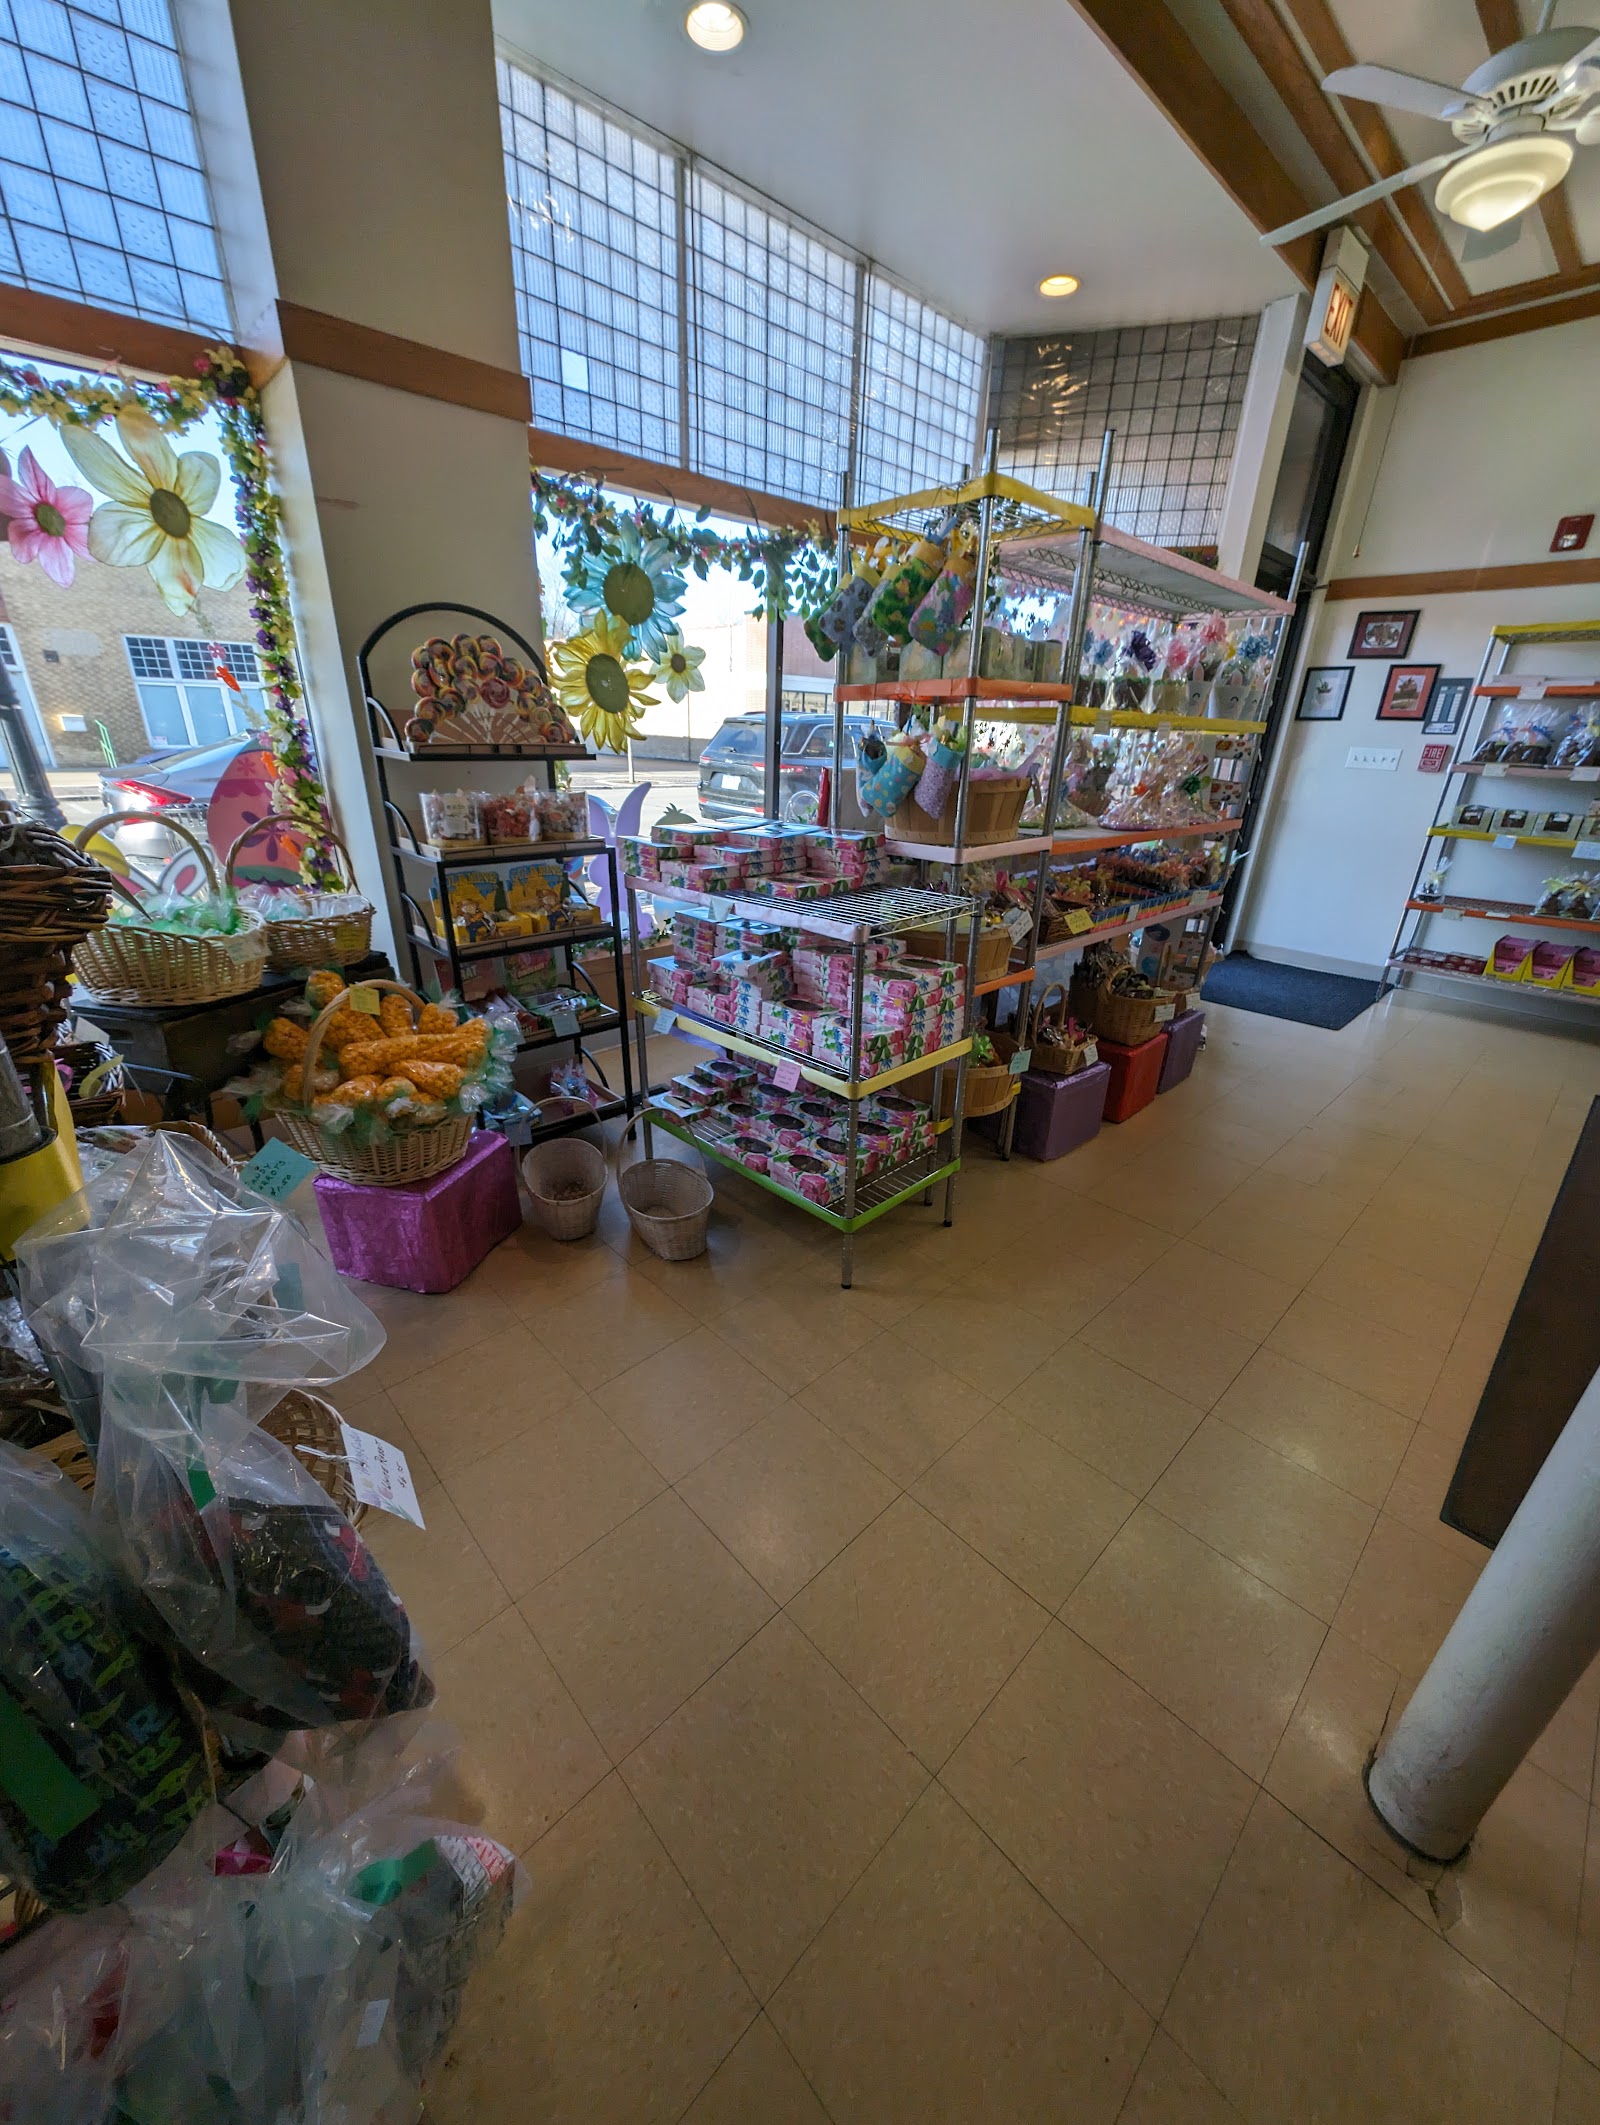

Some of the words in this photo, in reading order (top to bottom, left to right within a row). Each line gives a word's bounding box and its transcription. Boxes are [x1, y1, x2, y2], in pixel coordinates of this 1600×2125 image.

[1324, 283, 1353, 347] EXIT
[1422, 747, 1443, 759] FIRE
[251, 1160, 287, 1191] ARROTS
